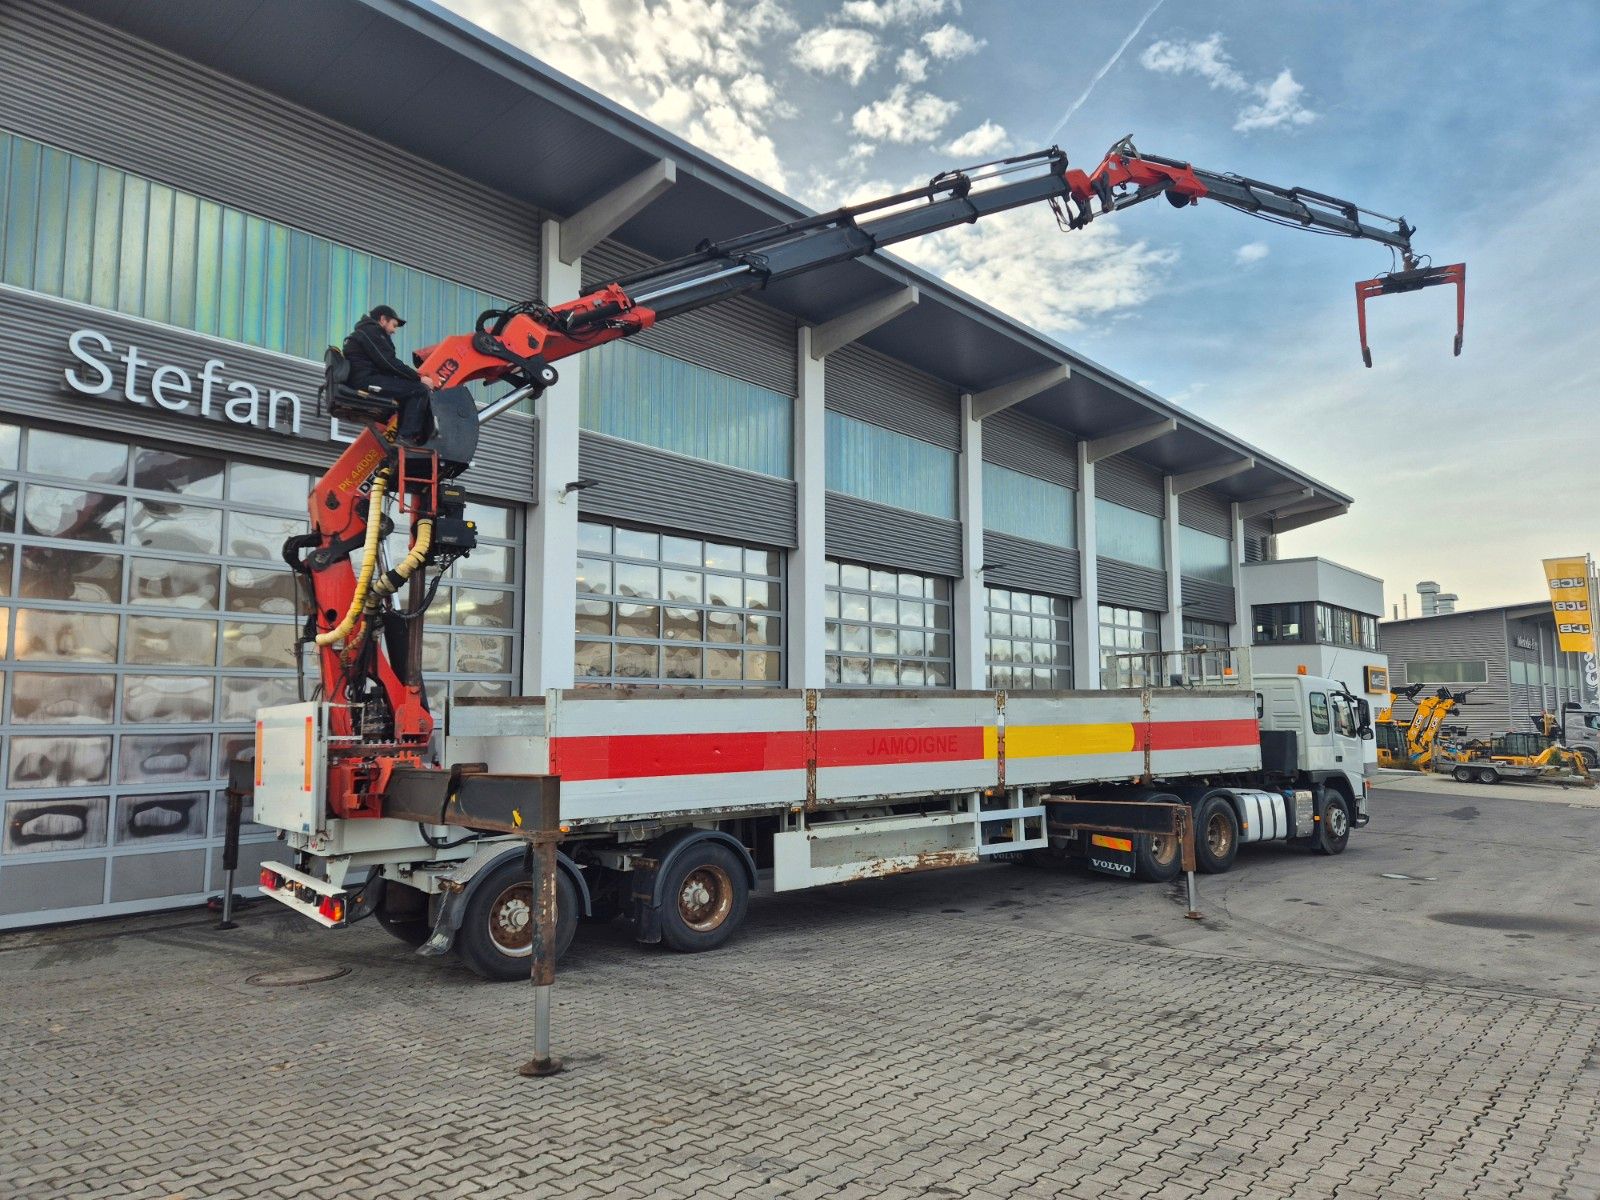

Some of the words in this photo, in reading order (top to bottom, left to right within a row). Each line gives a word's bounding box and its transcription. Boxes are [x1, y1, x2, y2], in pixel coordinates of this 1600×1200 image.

[64, 329, 300, 434] Stefan
[866, 735, 958, 755] JAMOIGNE
[1091, 858, 1132, 873] VOLVO
